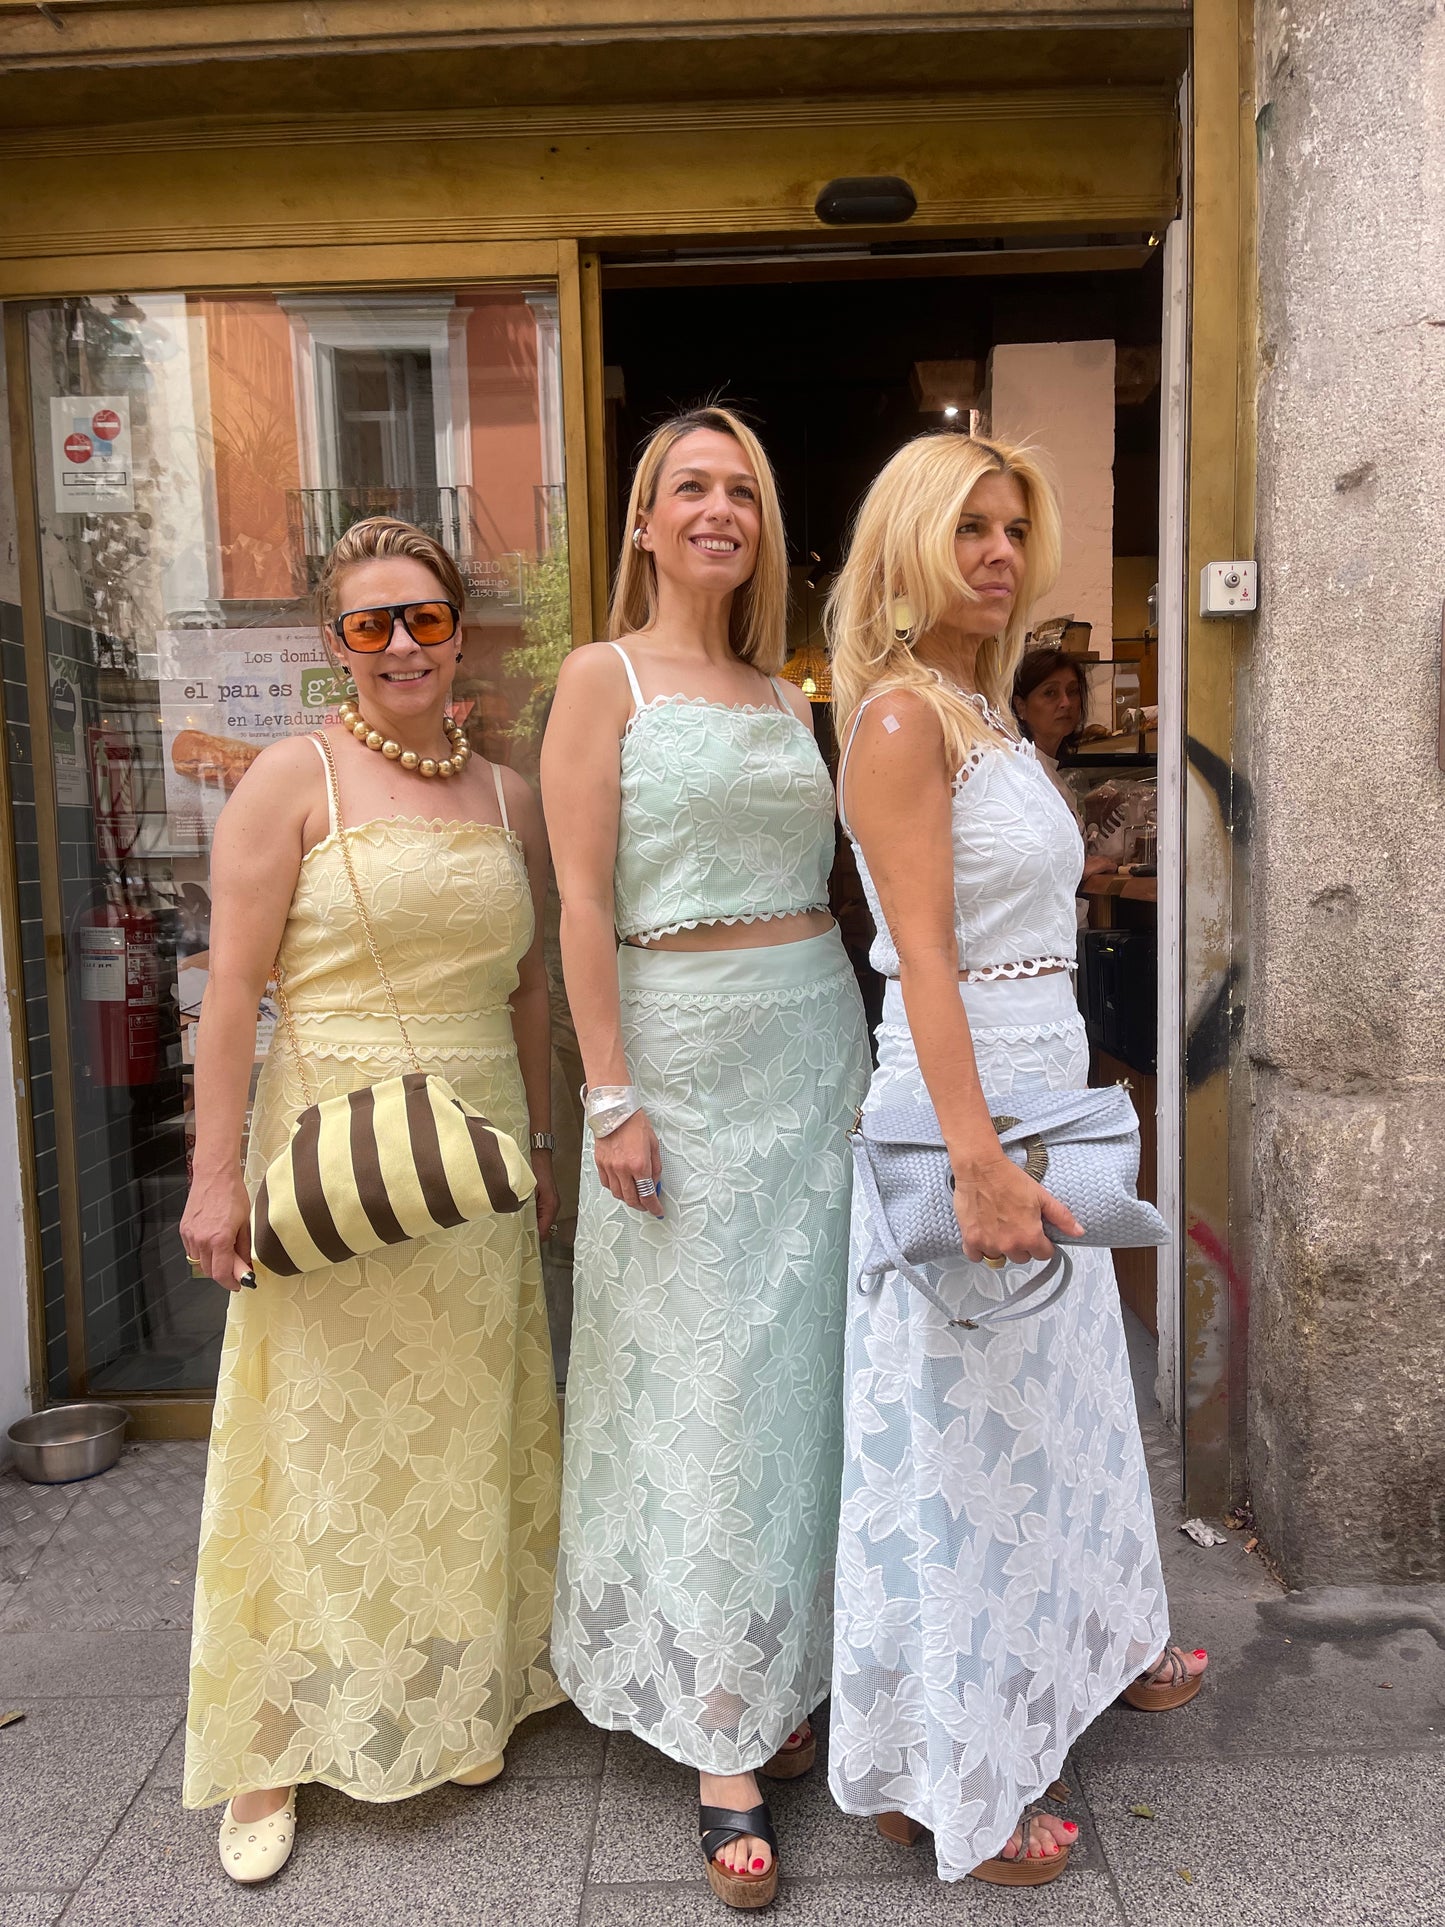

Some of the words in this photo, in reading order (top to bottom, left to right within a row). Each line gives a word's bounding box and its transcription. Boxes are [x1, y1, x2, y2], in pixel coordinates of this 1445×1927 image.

[454, 561, 500, 574] RARIO
[467, 578, 509, 589] Domingo
[244, 651, 273, 664] Los
[280, 648, 340, 666] domin
[184, 682, 208, 699] el
[218, 684, 260, 703] pan
[269, 683, 292, 697] es
[306, 676, 358, 706] gra
[227, 714, 247, 727] en
[255, 712, 344, 727] Levaduram
